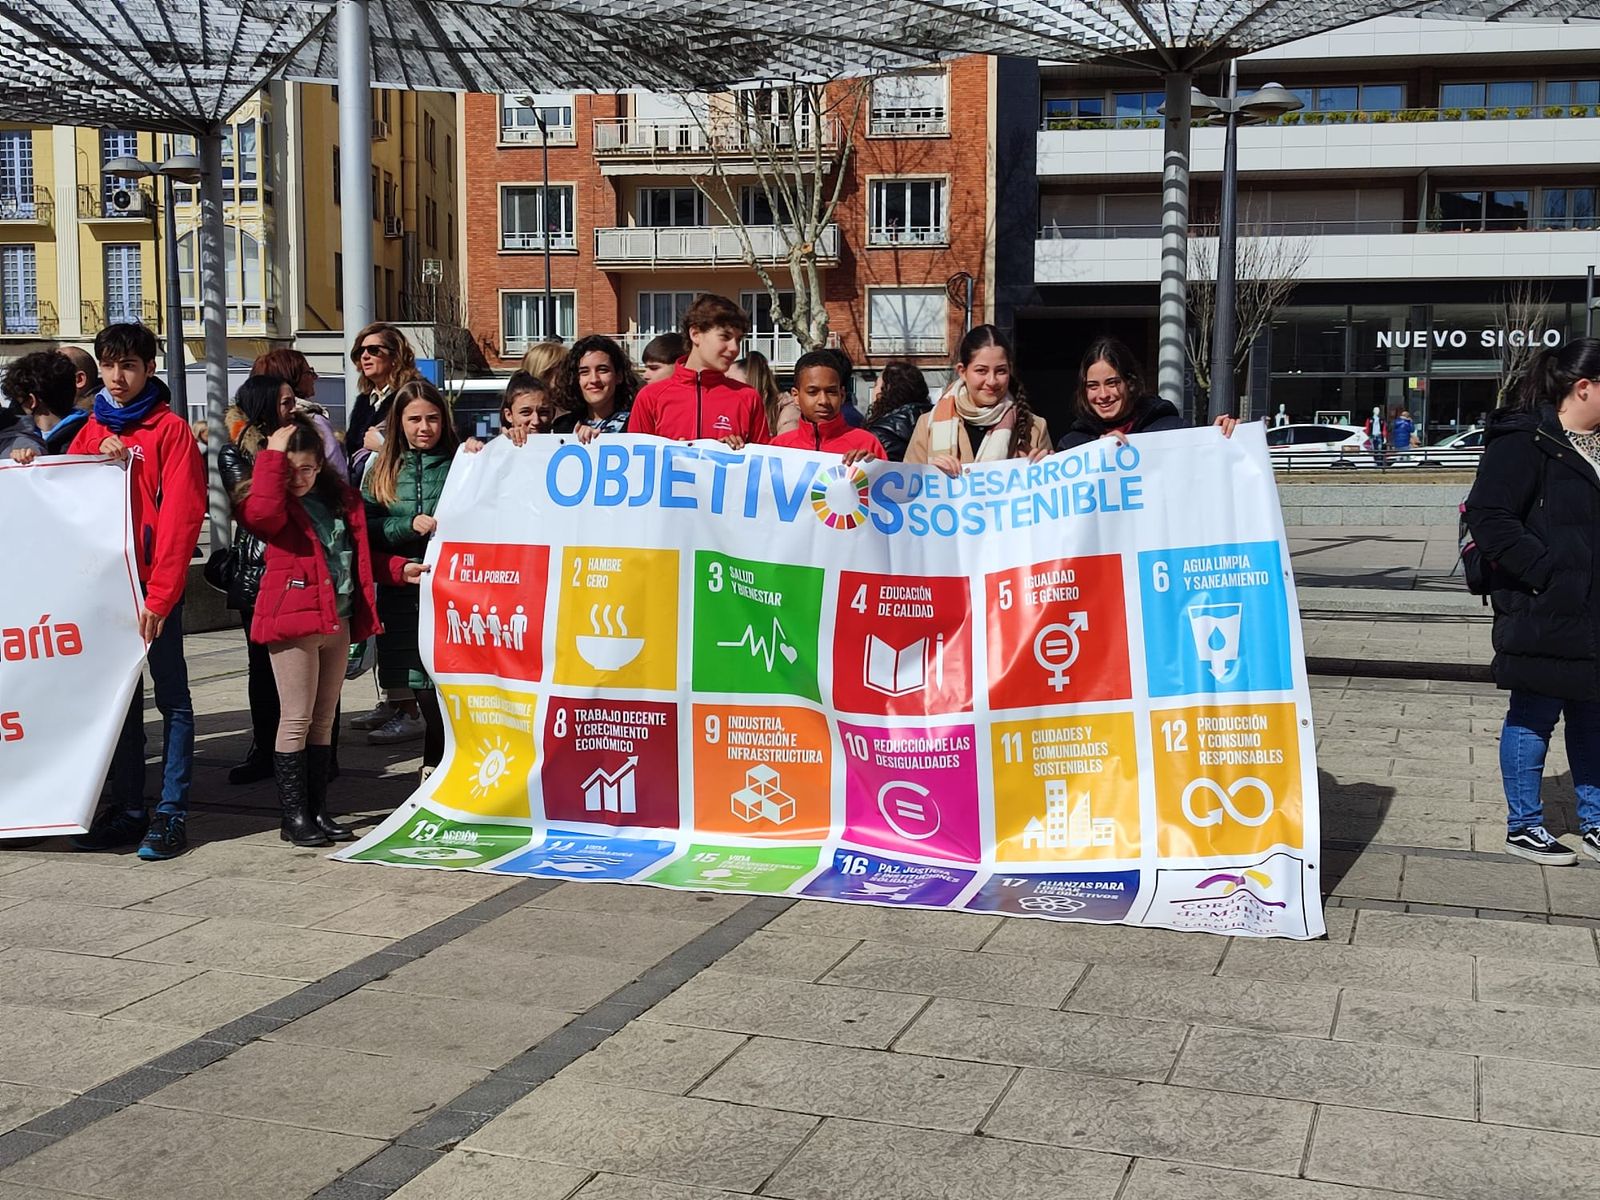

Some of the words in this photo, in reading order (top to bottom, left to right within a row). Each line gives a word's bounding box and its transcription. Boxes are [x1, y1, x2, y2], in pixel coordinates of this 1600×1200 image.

[1377, 330, 1467, 348] NUEVO
[1480, 329, 1561, 348] SIGLO
[907, 473, 939, 499] DE
[950, 444, 1140, 500] DESARROLLO
[908, 476, 1144, 537] SOSTENIBLE
[449, 553, 459, 581] 1
[463, 553, 475, 566] FIN
[588, 557, 623, 572] HAMBRE
[1183, 559, 1213, 574] AGUA
[1214, 554, 1251, 570] LIMPIA
[460, 569, 471, 582] DE
[473, 570, 483, 584] LA
[484, 570, 520, 584] POBREZA
[572, 557, 583, 587] 2
[586, 574, 609, 588] CERO
[708, 561, 723, 593] 3
[729, 566, 754, 585] SALUD
[1024, 569, 1075, 589] IGUALDAD
[1152, 560, 1170, 593] 6
[1184, 577, 1192, 591] Y
[1193, 570, 1269, 590] SANEAMIENTO
[731, 581, 738, 594] Y
[737, 583, 782, 607] BIENESTAR
[850, 583, 868, 614] 4
[879, 585, 933, 602] EDUCACIÓN
[998, 579, 1013, 611] 5
[1025, 591, 1039, 606] DE
[877, 602, 893, 617] DE
[893, 603, 934, 618] CALIDAD
[0, 614, 83, 661] aría
[448, 694, 461, 721] 7
[553, 707, 567, 738] 8
[574, 708, 621, 722] TRABAJO
[622, 711, 667, 726] DECENTE
[728, 715, 785, 731] INDUSTRIA,
[1197, 714, 1268, 731] PRODUCCIÓN
[575, 724, 582, 737] Y
[584, 723, 649, 740] CRECIMIENTO
[705, 714, 720, 744] 9
[1031, 727, 1083, 744] CIUDADES
[1084, 726, 1092, 739] Y
[1161, 719, 1188, 752] 12
[575, 736, 634, 753] ECONÓMICO
[728, 730, 790, 747] INNOVACIÓN
[791, 733, 798, 747] E
[845, 732, 869, 761] 10
[873, 738, 933, 754] REDUCCIÓN
[935, 738, 949, 752] DE
[950, 736, 970, 751] LAS
[1001, 731, 1023, 763] 11
[1198, 734, 1206, 748] Y
[1207, 732, 1261, 748] CONSUMO
[727, 746, 824, 764] INFRAESTRUCTURA
[1032, 742, 1108, 760] COMUNIDADES
[1199, 749, 1284, 765] RESPONSABLES
[875, 754, 960, 769] DESIGUALDADES
[1033, 759, 1104, 777] SOSTENIBLES
[840, 855, 869, 876] 16
[1001, 878, 1029, 887] 17
[1039, 880, 1094, 890] ALIANZAS
[1094, 881, 1125, 891] PARA
